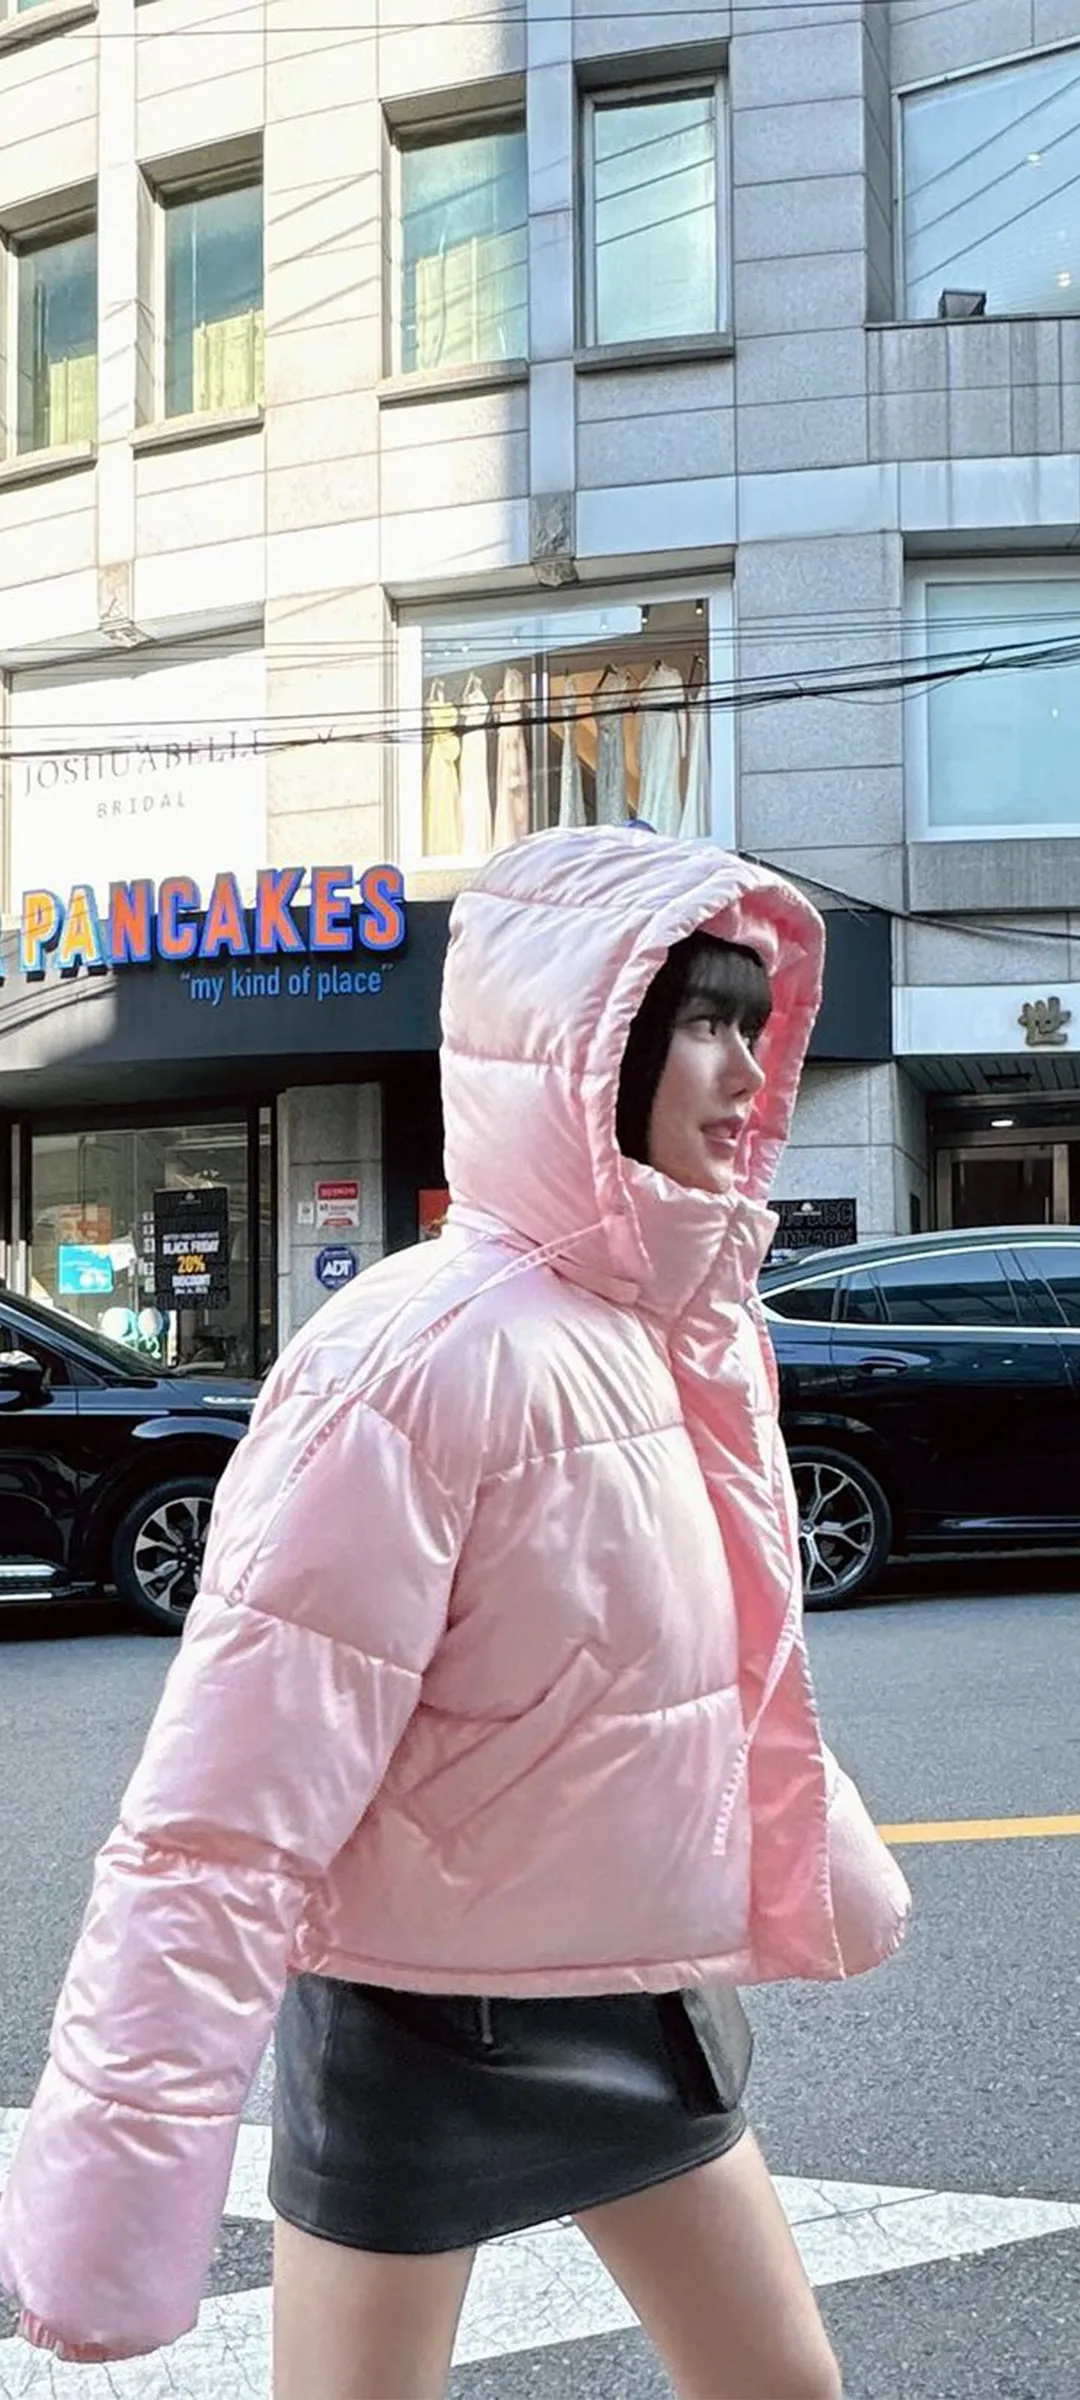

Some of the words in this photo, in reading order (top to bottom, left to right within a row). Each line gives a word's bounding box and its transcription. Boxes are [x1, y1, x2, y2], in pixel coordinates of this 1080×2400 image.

[96, 789, 186, 819] BRIDAL
[19, 864, 406, 974] PANCAKES
[231, 966, 280, 997] kind
[288, 965, 311, 995] of
[1017, 996, 1071, 1046] 世
[163, 1241, 189, 1255] BLACK
[191, 1240, 219, 1253] FRIDAY
[177, 1254, 206, 1274] 20%
[321, 1260, 353, 1276] ADT
